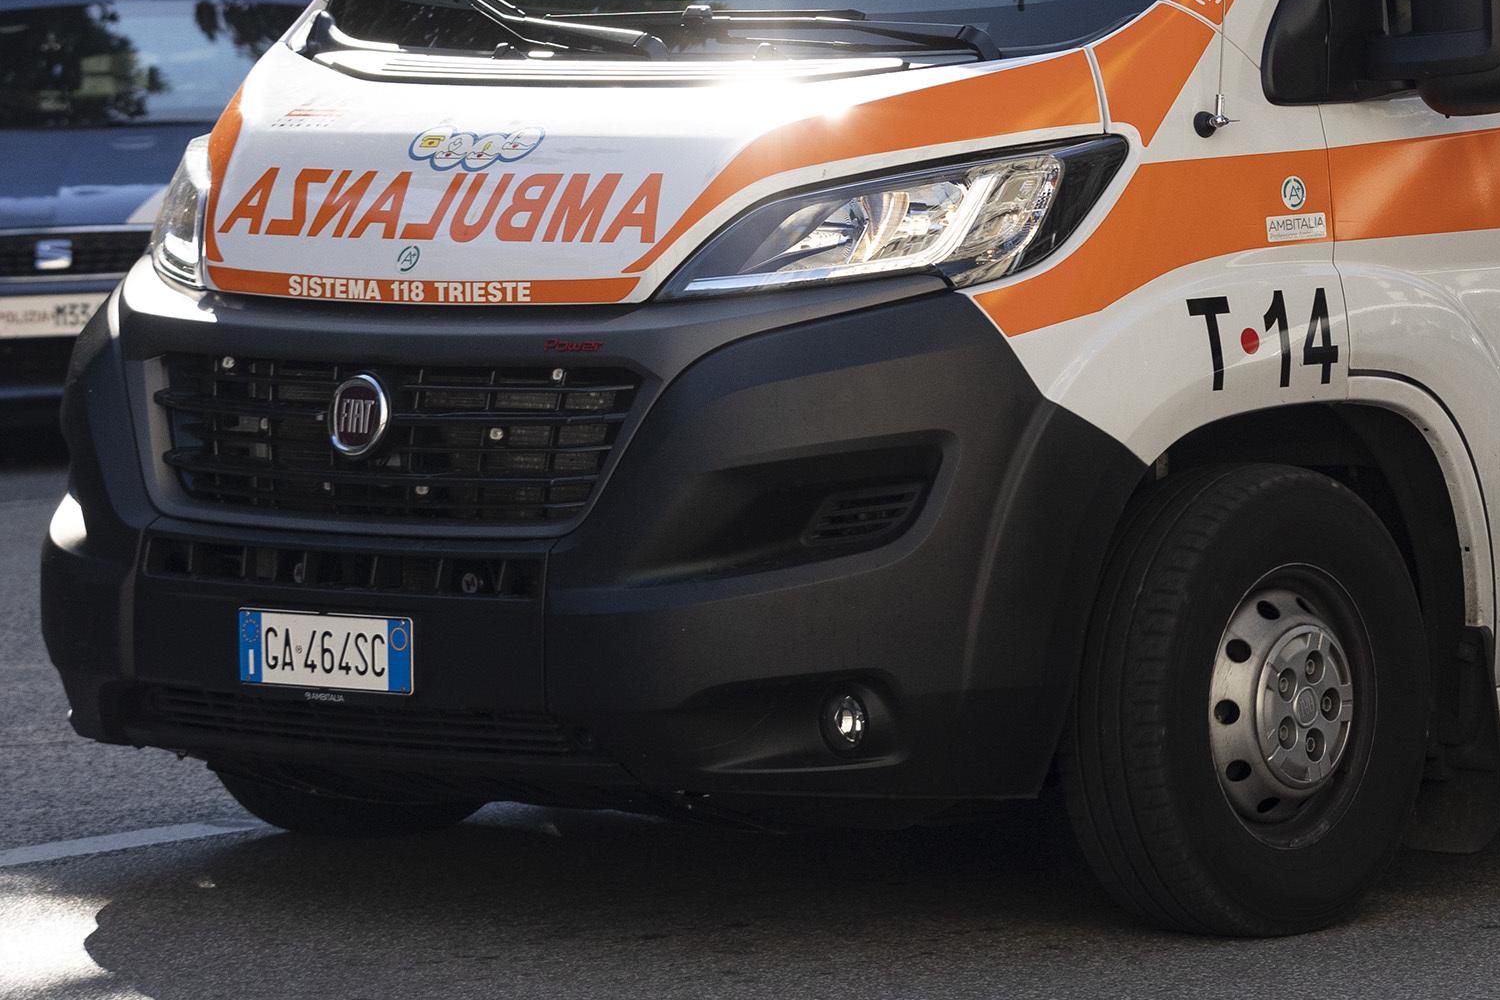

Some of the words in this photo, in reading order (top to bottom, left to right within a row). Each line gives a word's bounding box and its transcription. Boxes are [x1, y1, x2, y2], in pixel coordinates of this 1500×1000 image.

[1268, 216, 1325, 232] AMBITALIA
[288, 275, 382, 300] SISTEMA
[391, 281, 424, 301] 118
[434, 281, 532, 302] TRIESTE
[340, 398, 375, 434] FIAT
